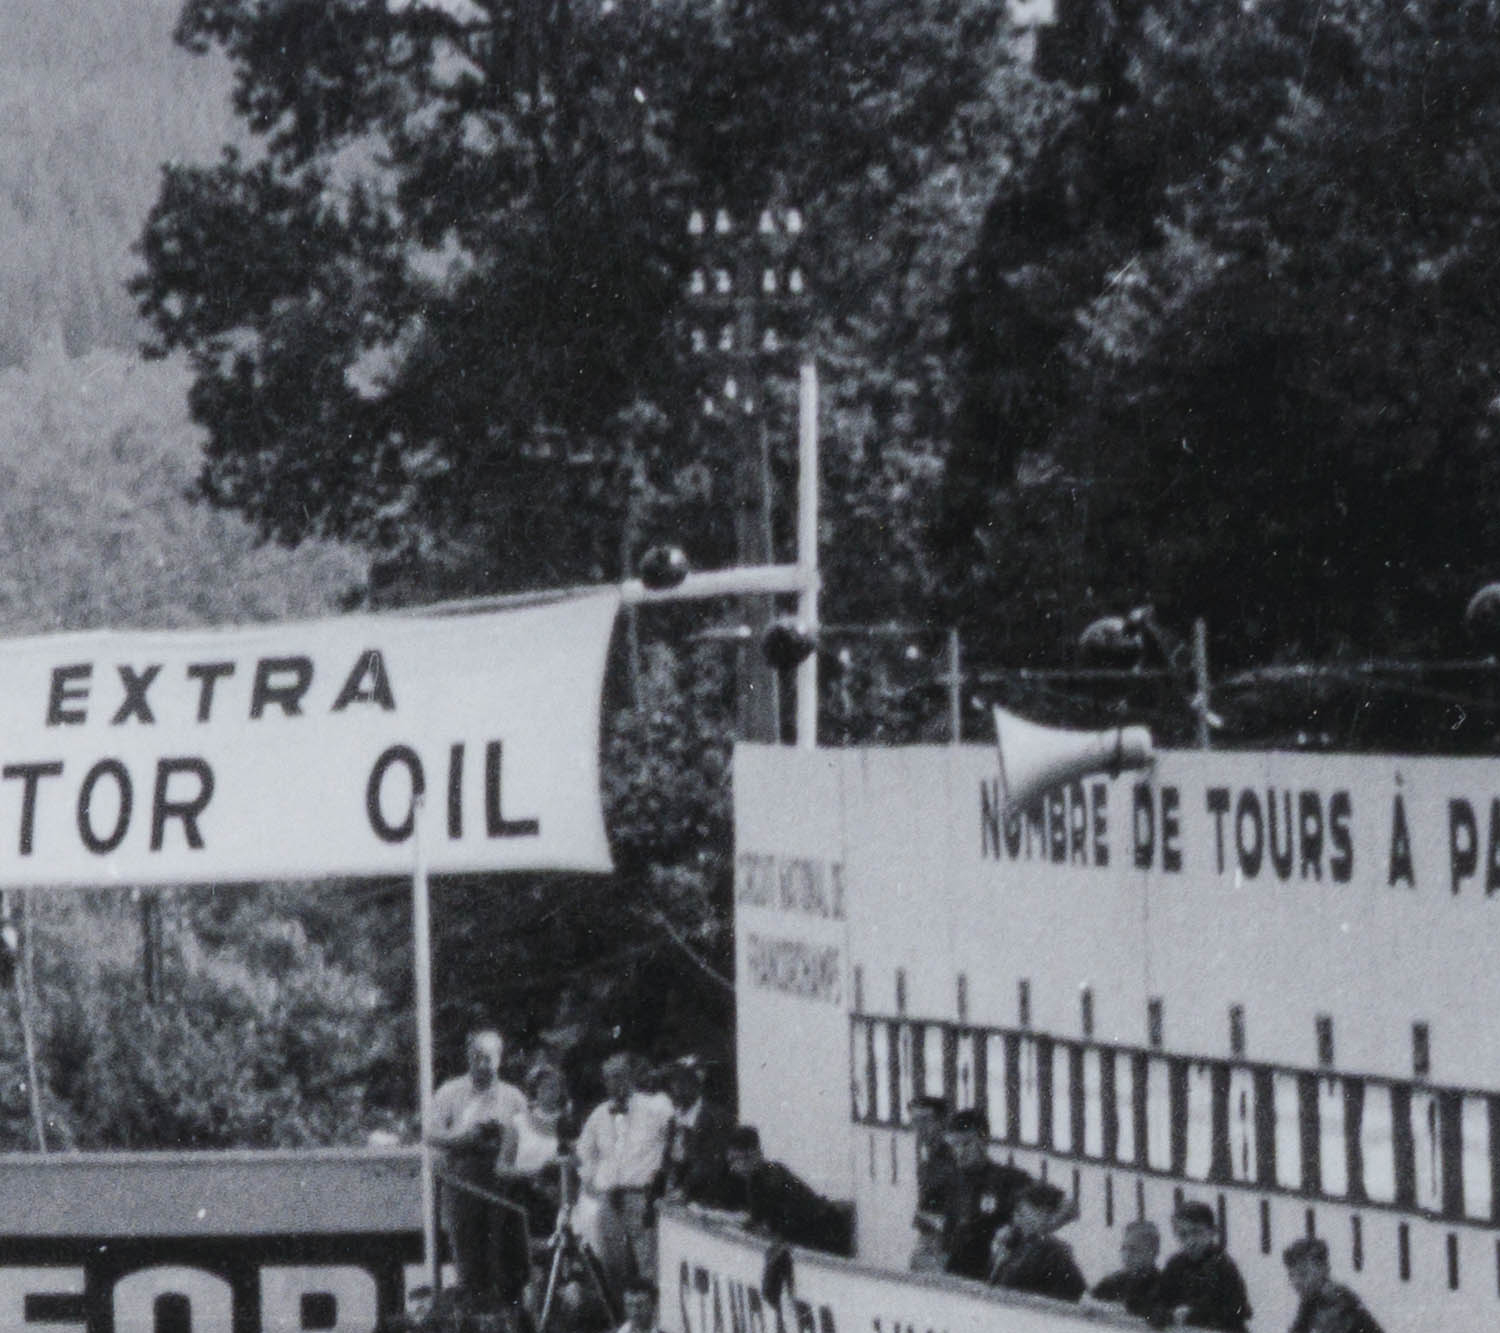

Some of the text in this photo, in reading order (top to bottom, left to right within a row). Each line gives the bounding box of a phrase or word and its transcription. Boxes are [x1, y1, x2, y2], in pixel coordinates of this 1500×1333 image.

[46, 648, 397, 727] EXTRA
[364, 738, 541, 845] OIL
[1132, 782, 1184, 875] DE
[1205, 786, 1354, 885] TOURS
[1387, 773, 1416, 889] À
